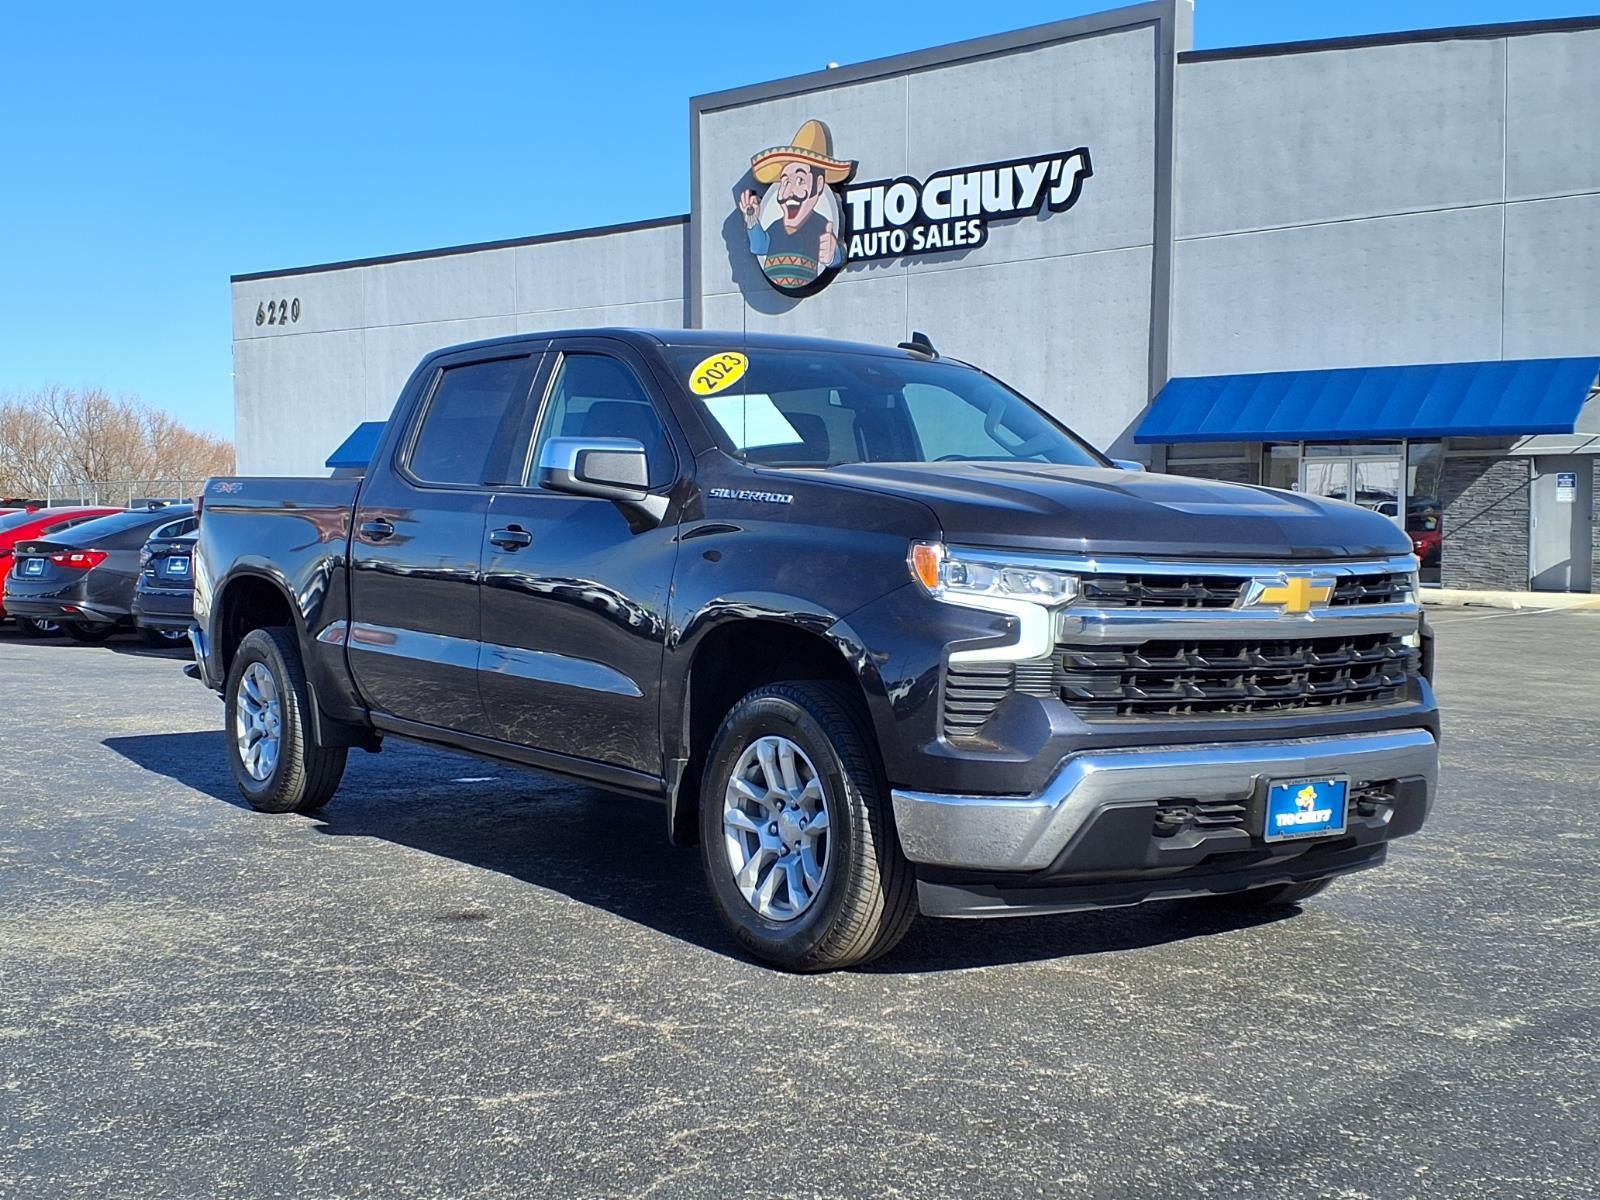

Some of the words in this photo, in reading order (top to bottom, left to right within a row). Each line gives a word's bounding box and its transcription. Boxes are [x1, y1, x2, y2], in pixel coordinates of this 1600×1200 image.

[846, 182, 918, 231] TIO
[921, 154, 1083, 220] CHUY'S
[848, 229, 906, 258] AUTO
[912, 219, 981, 251] SALES
[255, 297, 300, 326] 6220
[697, 354, 742, 389] 2023
[708, 487, 794, 504] SILVERADO
